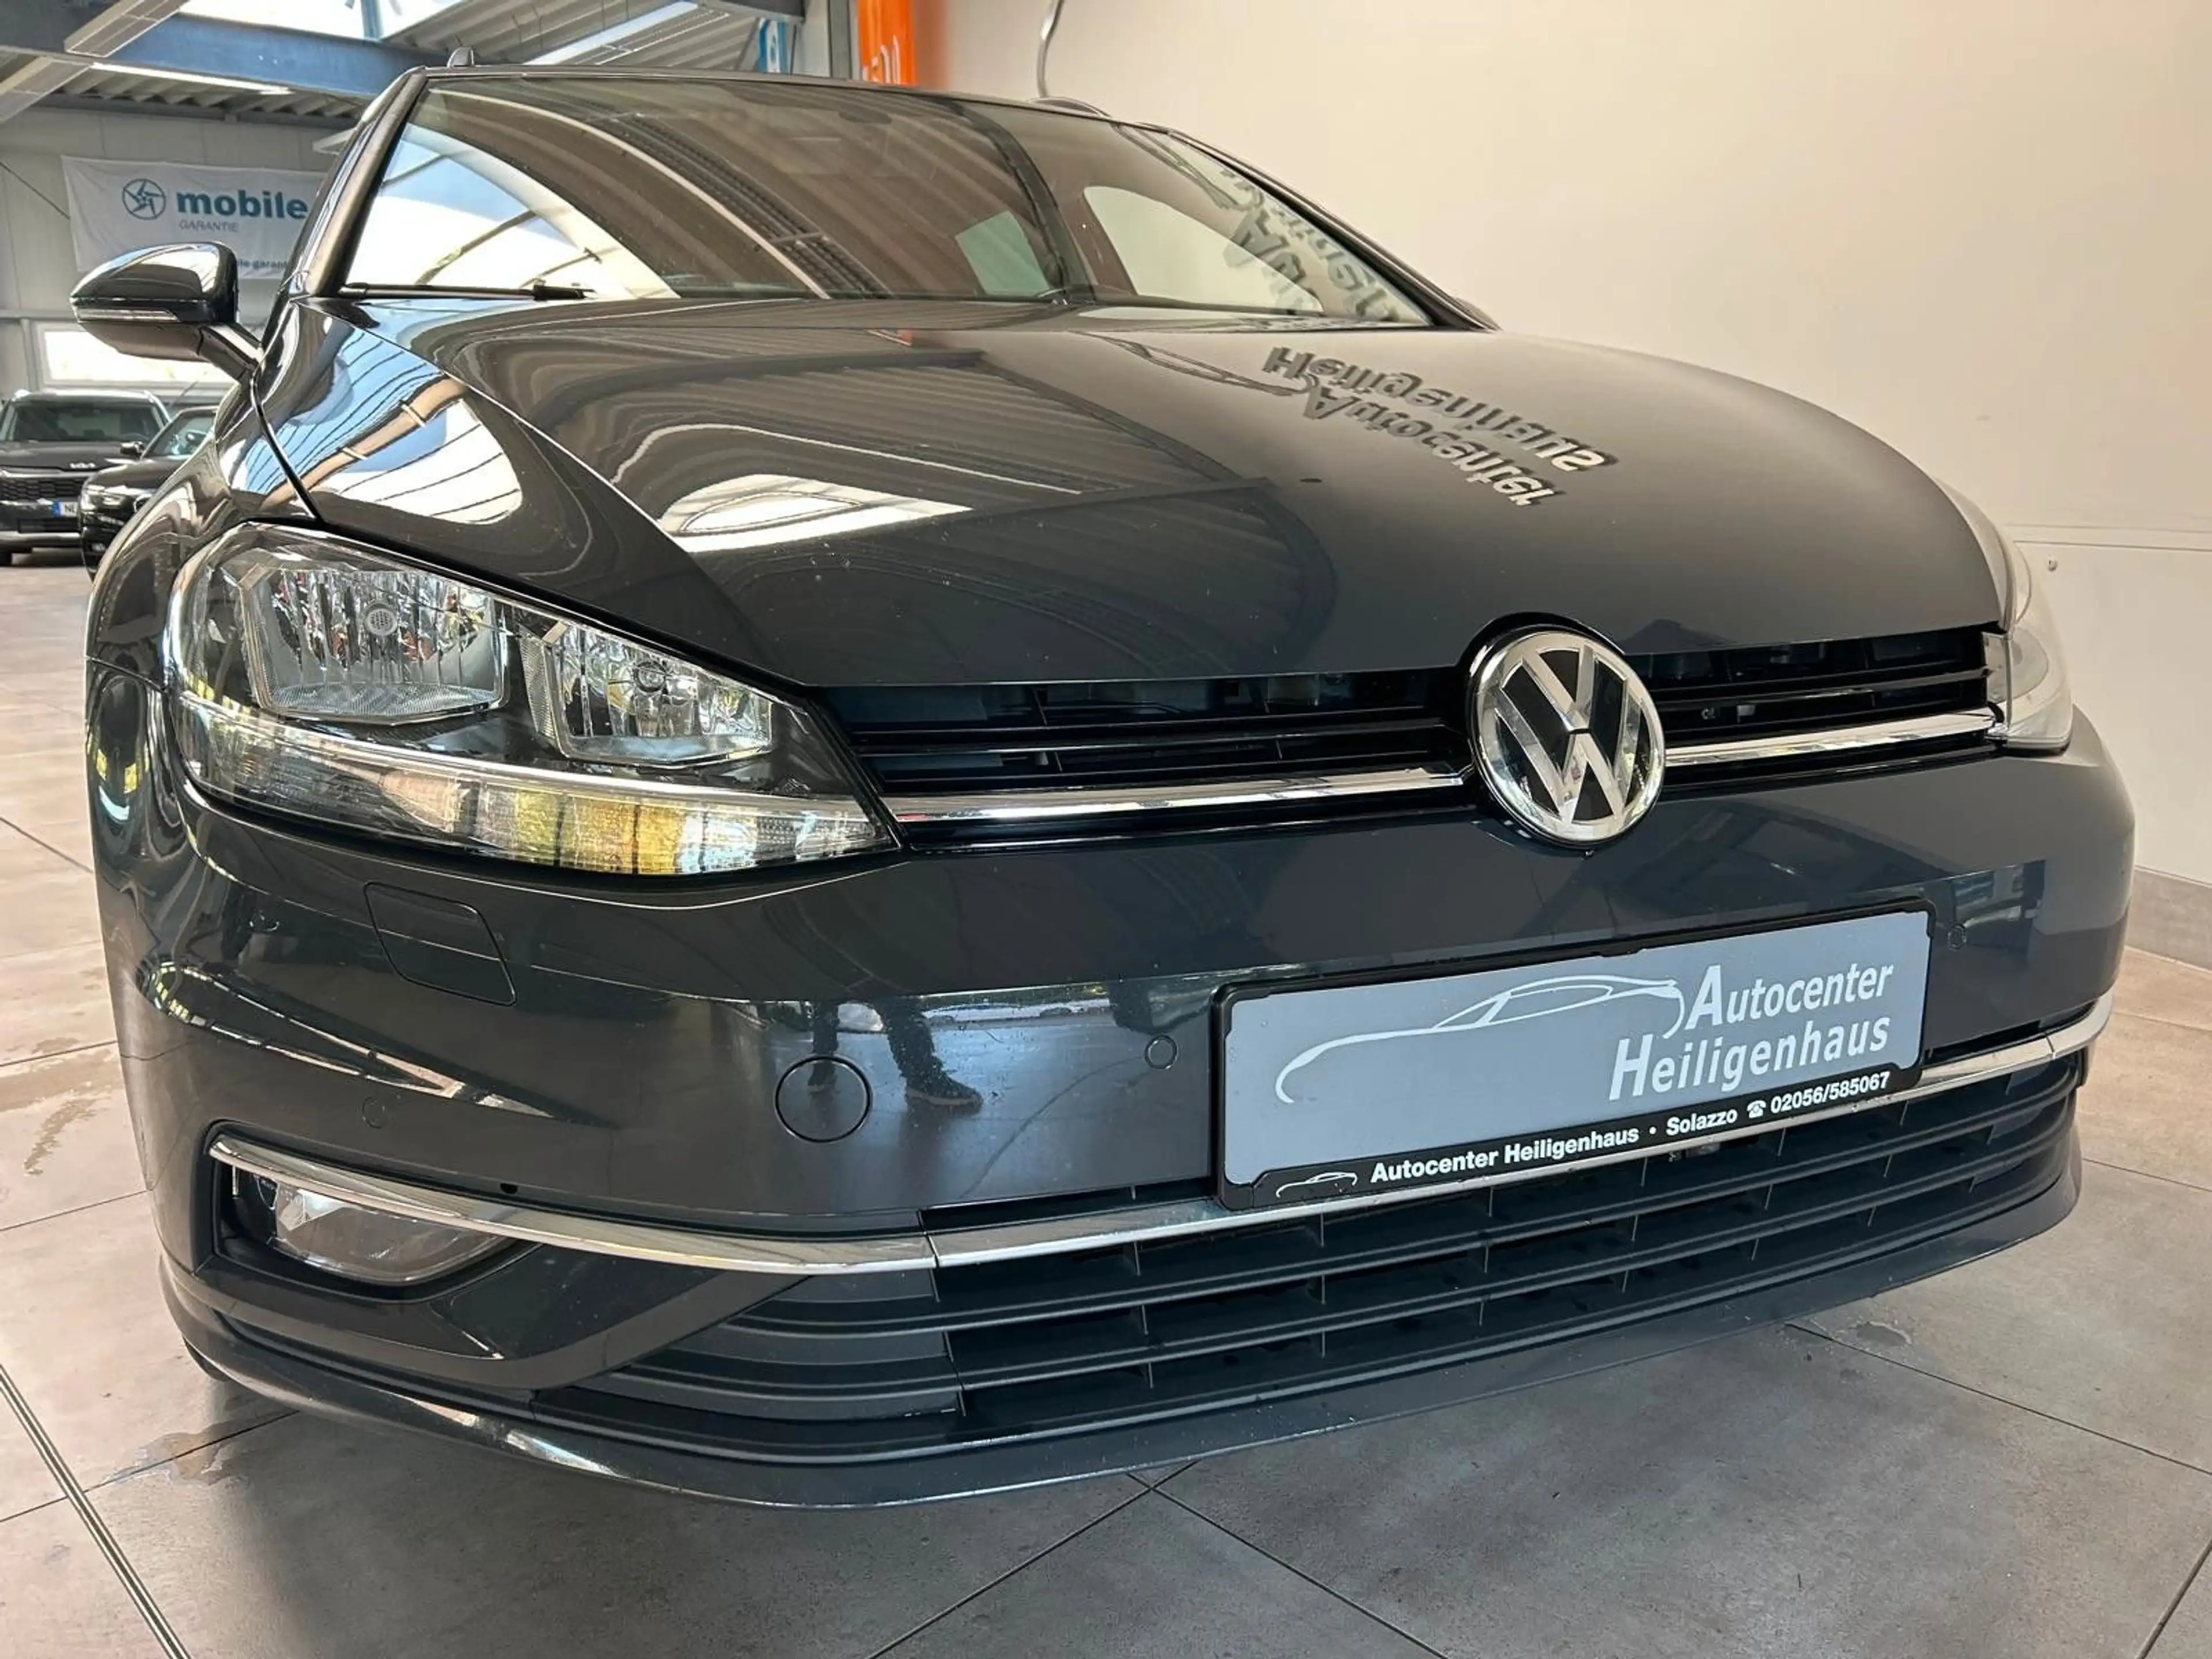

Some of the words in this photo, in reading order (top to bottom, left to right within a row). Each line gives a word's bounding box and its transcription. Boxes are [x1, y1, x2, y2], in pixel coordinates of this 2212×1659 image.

[176, 189, 308, 219] mobile
[179, 219, 238, 232] GARANTIE
[1684, 963, 1894, 1030] Autocenter
[1609, 1016, 1891, 1100] Heiligenhaus
[1370, 1150, 1499, 1184] Autocenter
[1504, 1126, 1639, 1164] Heiligenhaus
[1666, 1108, 1738, 1136] Solazzo
[1770, 1071, 1891, 1114] 02056/585067
